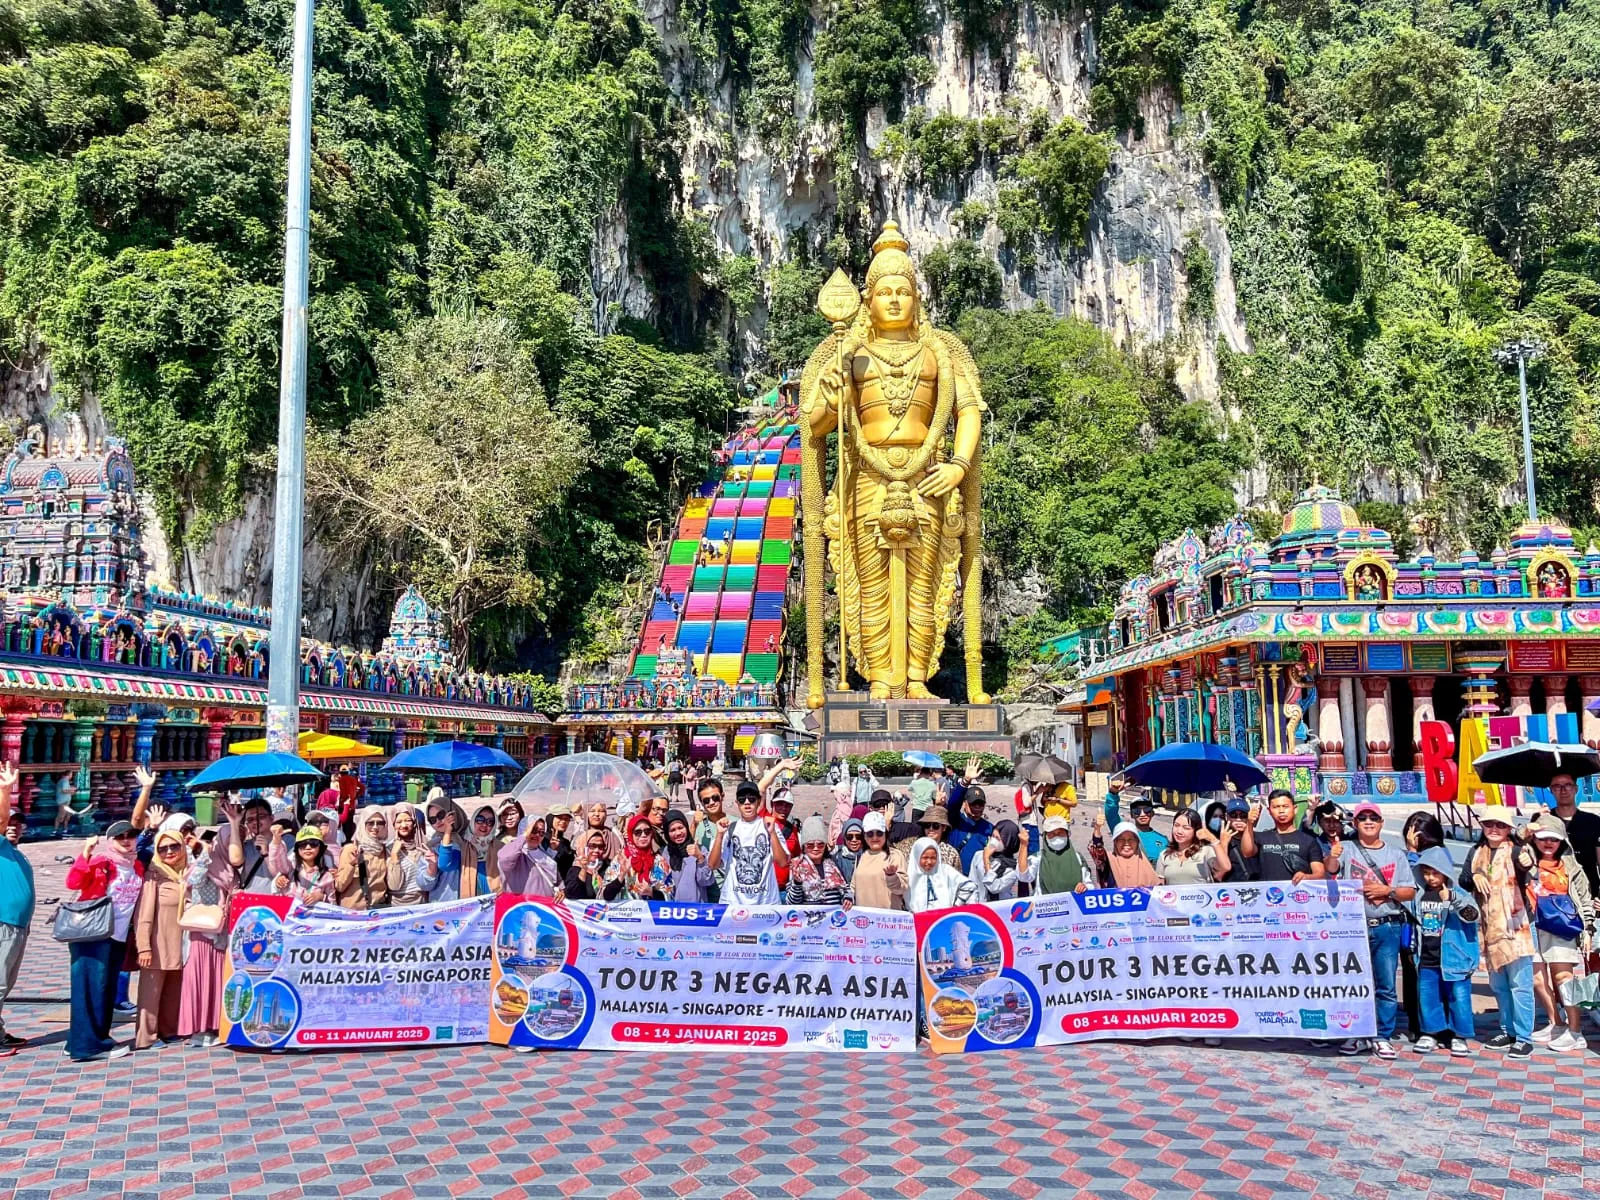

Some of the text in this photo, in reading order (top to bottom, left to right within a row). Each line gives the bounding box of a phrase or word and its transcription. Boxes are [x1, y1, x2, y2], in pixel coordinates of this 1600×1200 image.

[1085, 892, 1143, 909] BUS 2
[659, 907, 716, 921] BUS 1
[289, 944, 493, 964] TOUR 2 NEGARA ASIA
[299, 969, 381, 985] MALAYSIA
[396, 967, 491, 983] SINGAPORE
[1037, 951, 1364, 986] TOUR 3 NEGARA ASIA
[598, 967, 909, 999] TOUR 3 NEGARA ASIA
[1045, 988, 1113, 1008] MALAYSIA
[1126, 986, 1209, 1000] SINGAPORE
[1222, 985, 1300, 999] THAILAND
[1303, 985, 1370, 1000] (HATYAI)
[600, 1000, 668, 1014] MALAYSIA
[682, 1002, 764, 1016] SINGAPORE
[777, 1005, 847, 1020] THAILAND
[851, 1007, 913, 1022] (HATYAI)
[1073, 1017, 1089, 1028] 08
[1102, 1014, 1119, 1025] 14
[1123, 1013, 1187, 1025] JANUARI
[1190, 1012, 1227, 1024] 2025
[303, 1032, 317, 1041] 08
[326, 1031, 339, 1041] 11
[343, 1030, 394, 1041] JANUARI
[397, 1029, 423, 1039] 2025
[623, 1026, 640, 1037] 08
[654, 1028, 671, 1038] 14
[675, 1028, 739, 1041] JANUARI
[743, 1030, 777, 1042] 2025
